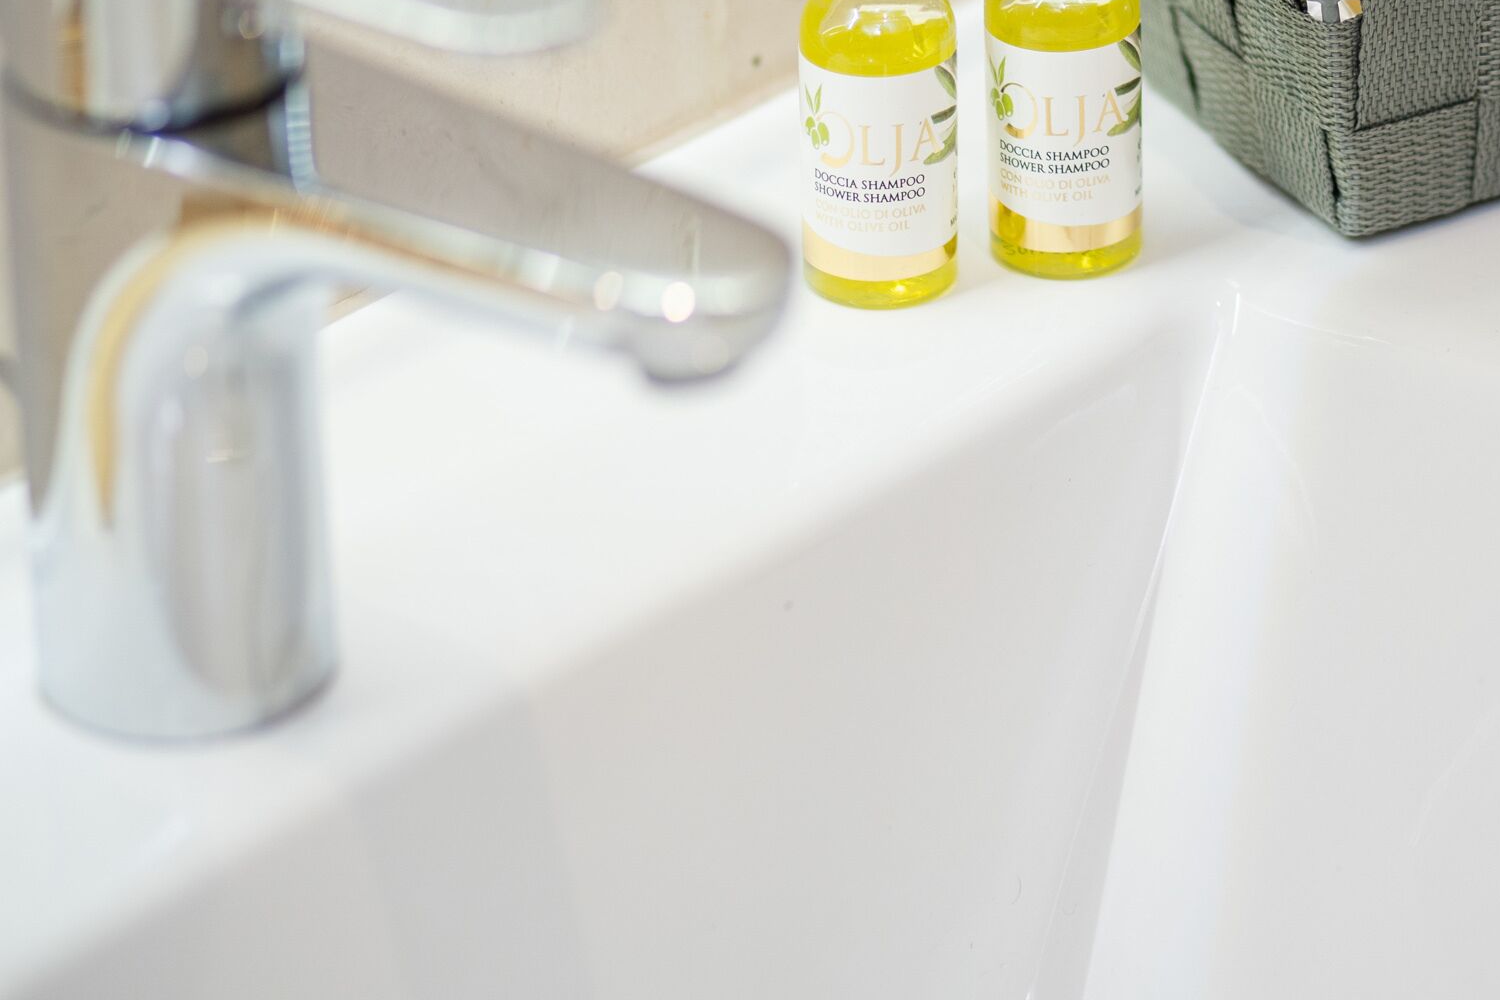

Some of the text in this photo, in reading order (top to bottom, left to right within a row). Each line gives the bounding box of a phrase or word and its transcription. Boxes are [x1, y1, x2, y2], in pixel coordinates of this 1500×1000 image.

[1002, 83, 1126, 147] OLJA
[815, 111, 945, 177] OLJA
[1000, 139, 1110, 161] DOCCIA SHAMPOO
[999, 153, 1110, 175] SHOWER SHAMPOO
[814, 168, 925, 190] DOCCIA SHAMPOO
[1000, 168, 1022, 185] CON
[1059, 179, 1072, 190] DI
[1076, 173, 1111, 188] OLIVA
[814, 181, 926, 204] SHOWER SHAMPOO
[1000, 182, 1028, 198] WITH
[1072, 190, 1094, 201] OIL
[874, 209, 889, 219] DI
[892, 203, 927, 218] OLIVA
[848, 219, 884, 233] OLIVE
[888, 220, 910, 231] OIL
